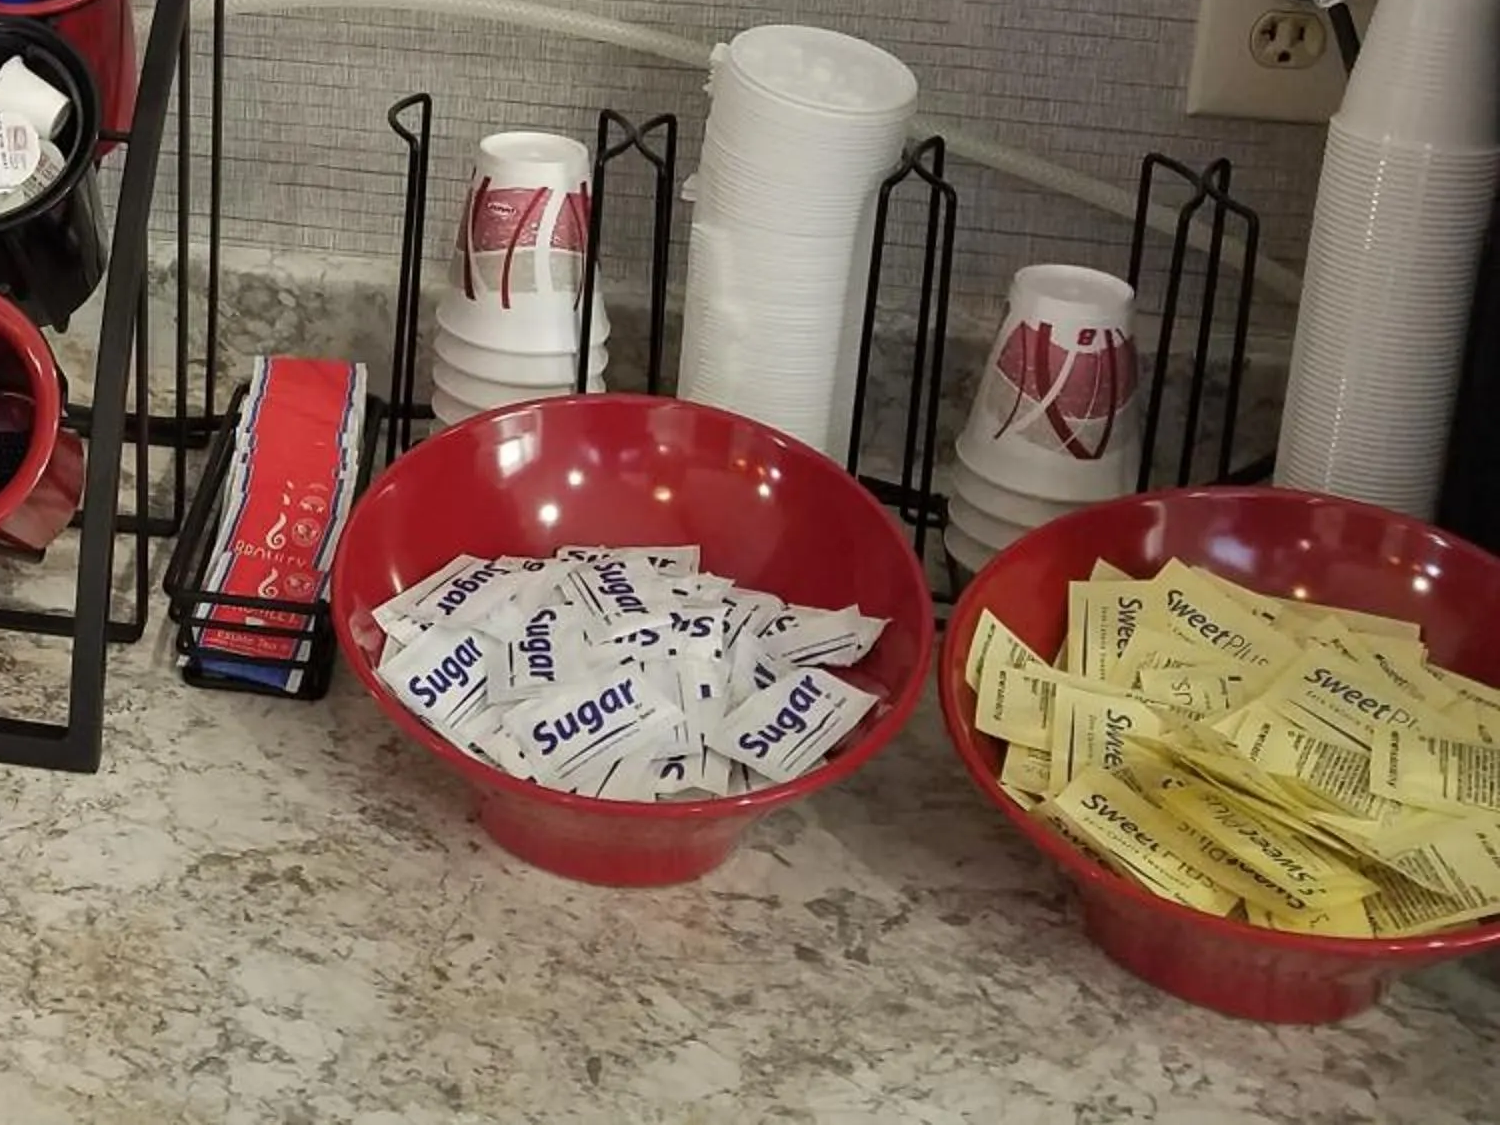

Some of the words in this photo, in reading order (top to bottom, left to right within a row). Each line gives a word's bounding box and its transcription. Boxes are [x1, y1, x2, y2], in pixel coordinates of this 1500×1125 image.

[437, 561, 510, 616] Sugar
[593, 561, 649, 614] Sugar
[408, 635, 484, 709] Sugar
[519, 609, 556, 682] Sugar
[532, 678, 636, 756] Sugar
[738, 674, 822, 759] Sugar
